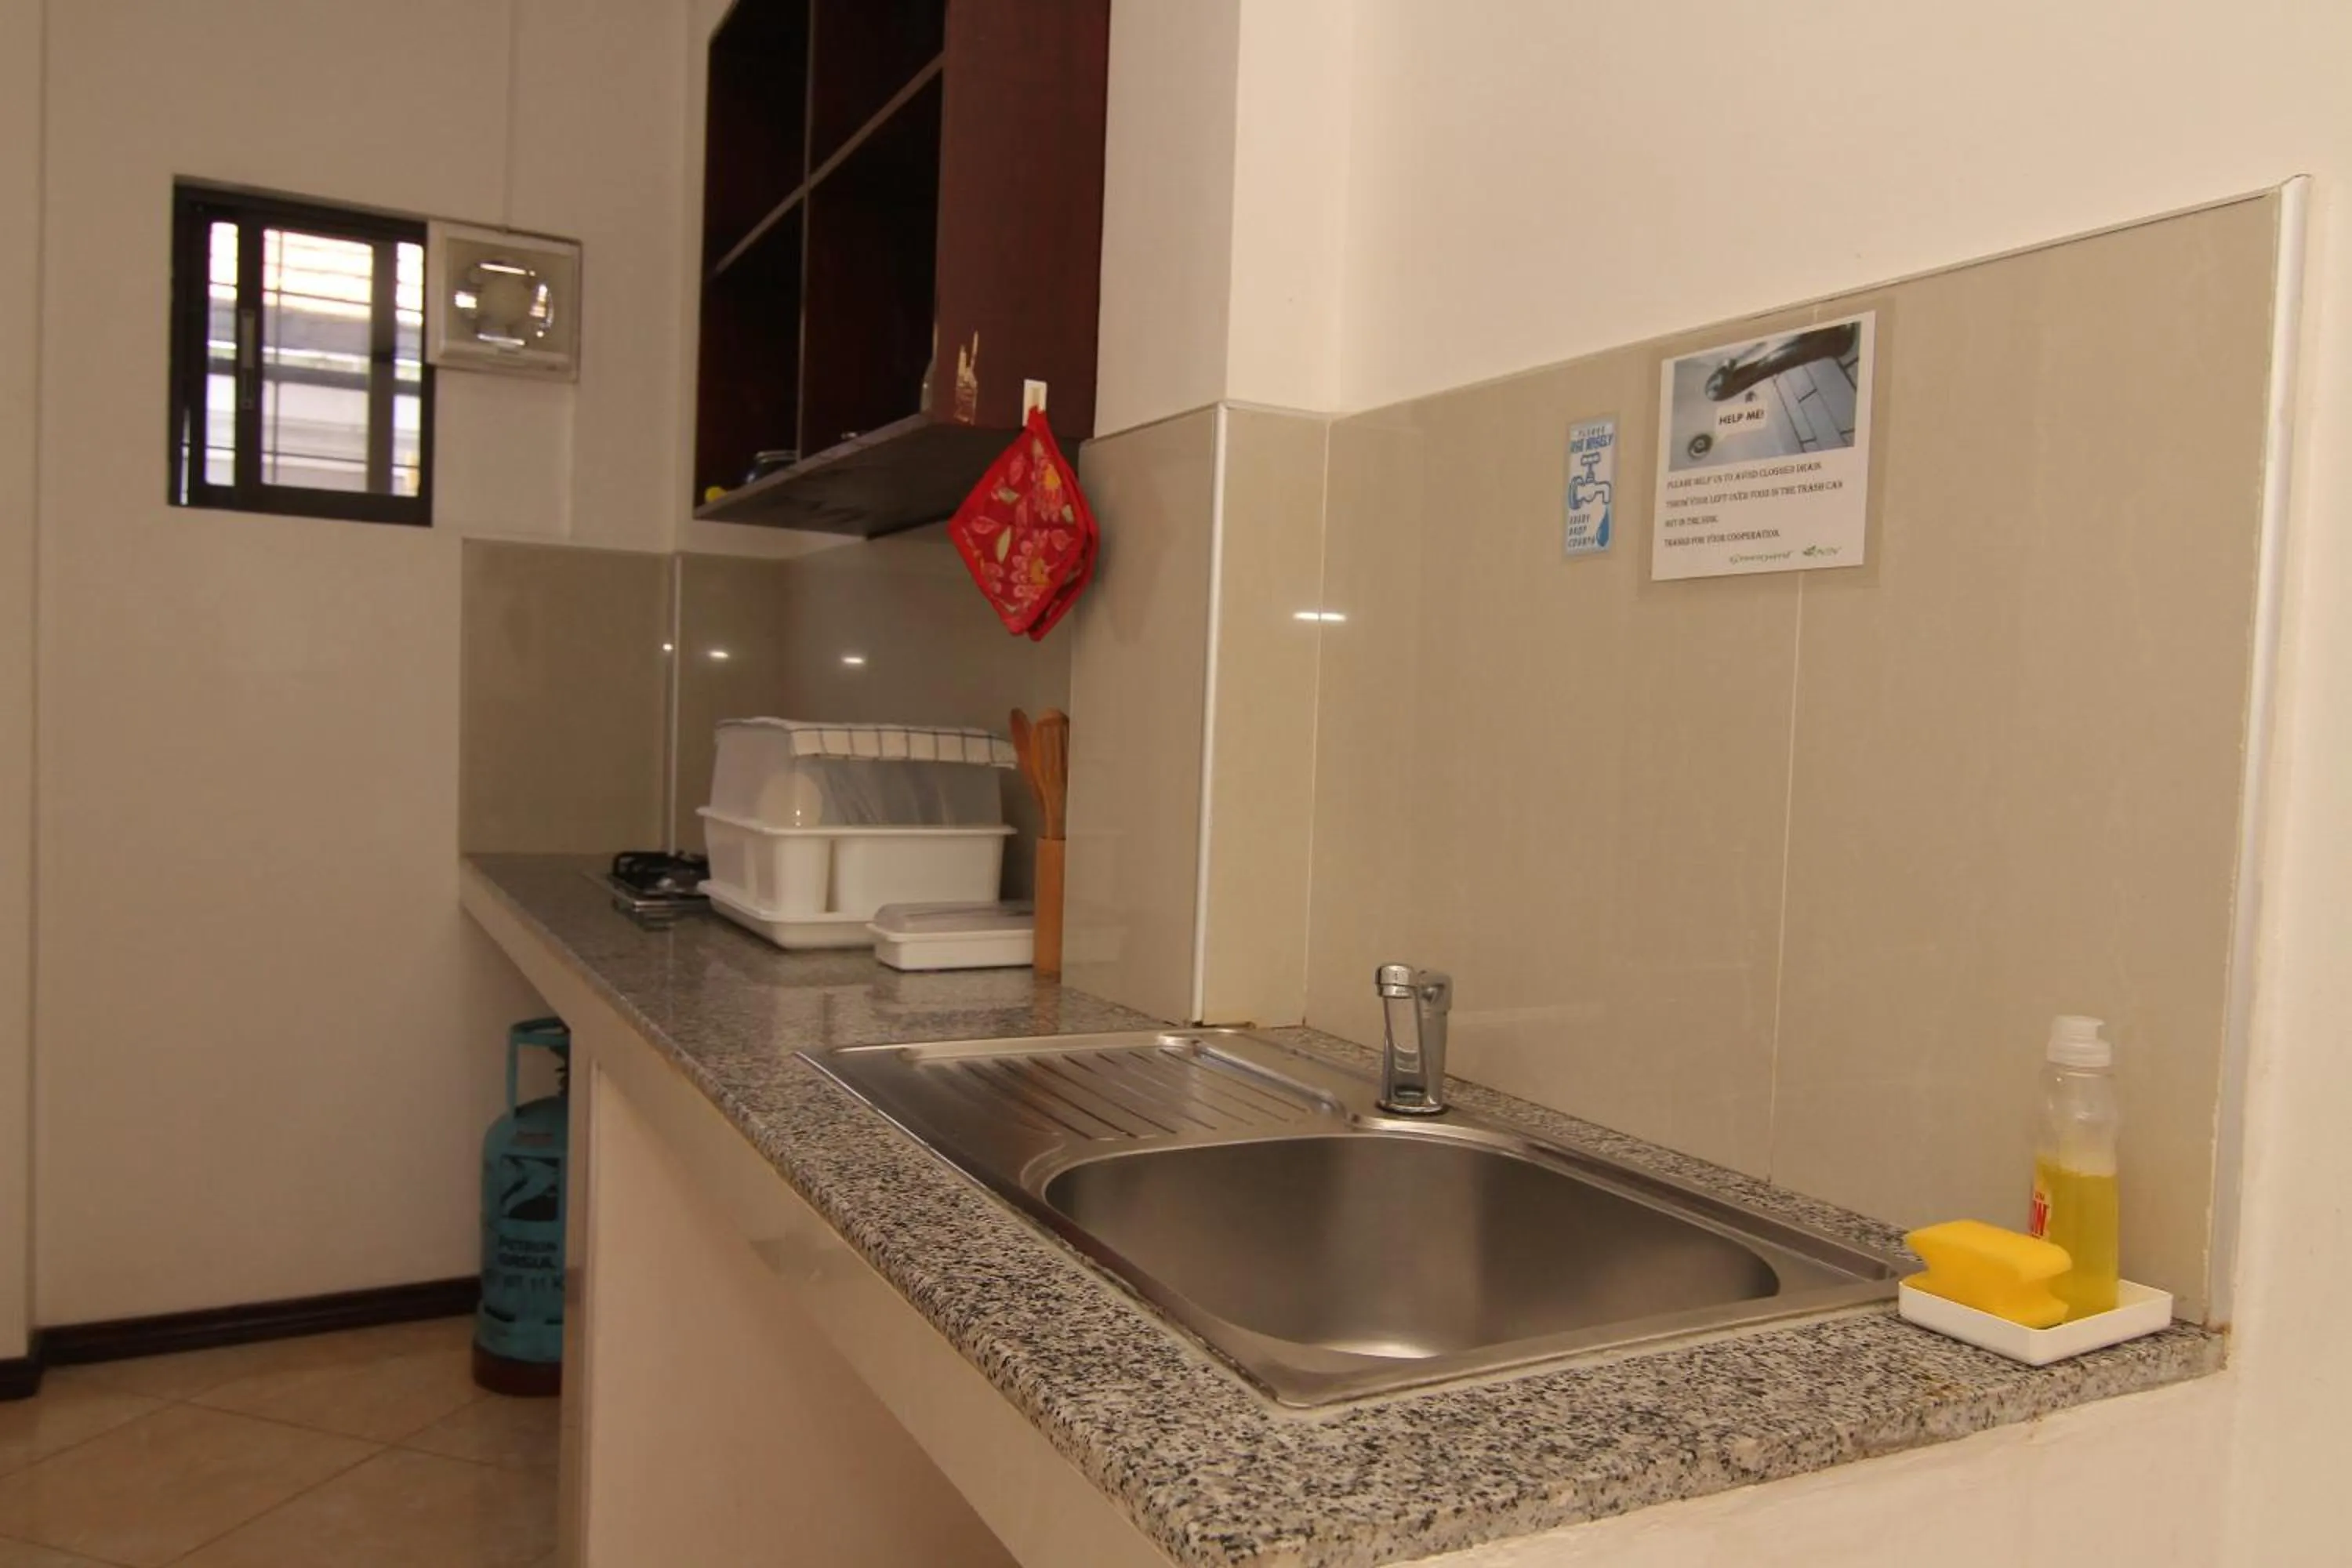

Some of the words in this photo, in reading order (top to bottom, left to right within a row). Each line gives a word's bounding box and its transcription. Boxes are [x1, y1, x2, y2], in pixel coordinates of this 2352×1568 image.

[1719, 412, 1744, 426] HELP
[1746, 408, 1765, 421] ME!
[1667, 478, 1692, 490] PLEASE
[1693, 475, 1713, 486] HELP
[1724, 473, 1733, 483] TO
[1734, 470, 1759, 481] AVOID
[1690, 495, 1708, 506] YOUR
[1710, 492, 1728, 504] LEFT
[1729, 490, 1749, 502] OVER
[1750, 488, 1769, 499] FOOD
[1780, 485, 1796, 496] THE
[1797, 481, 1824, 495] TRASH
[1824, 479, 1844, 491] CAN
[1707, 533, 1725, 544] YOUR
